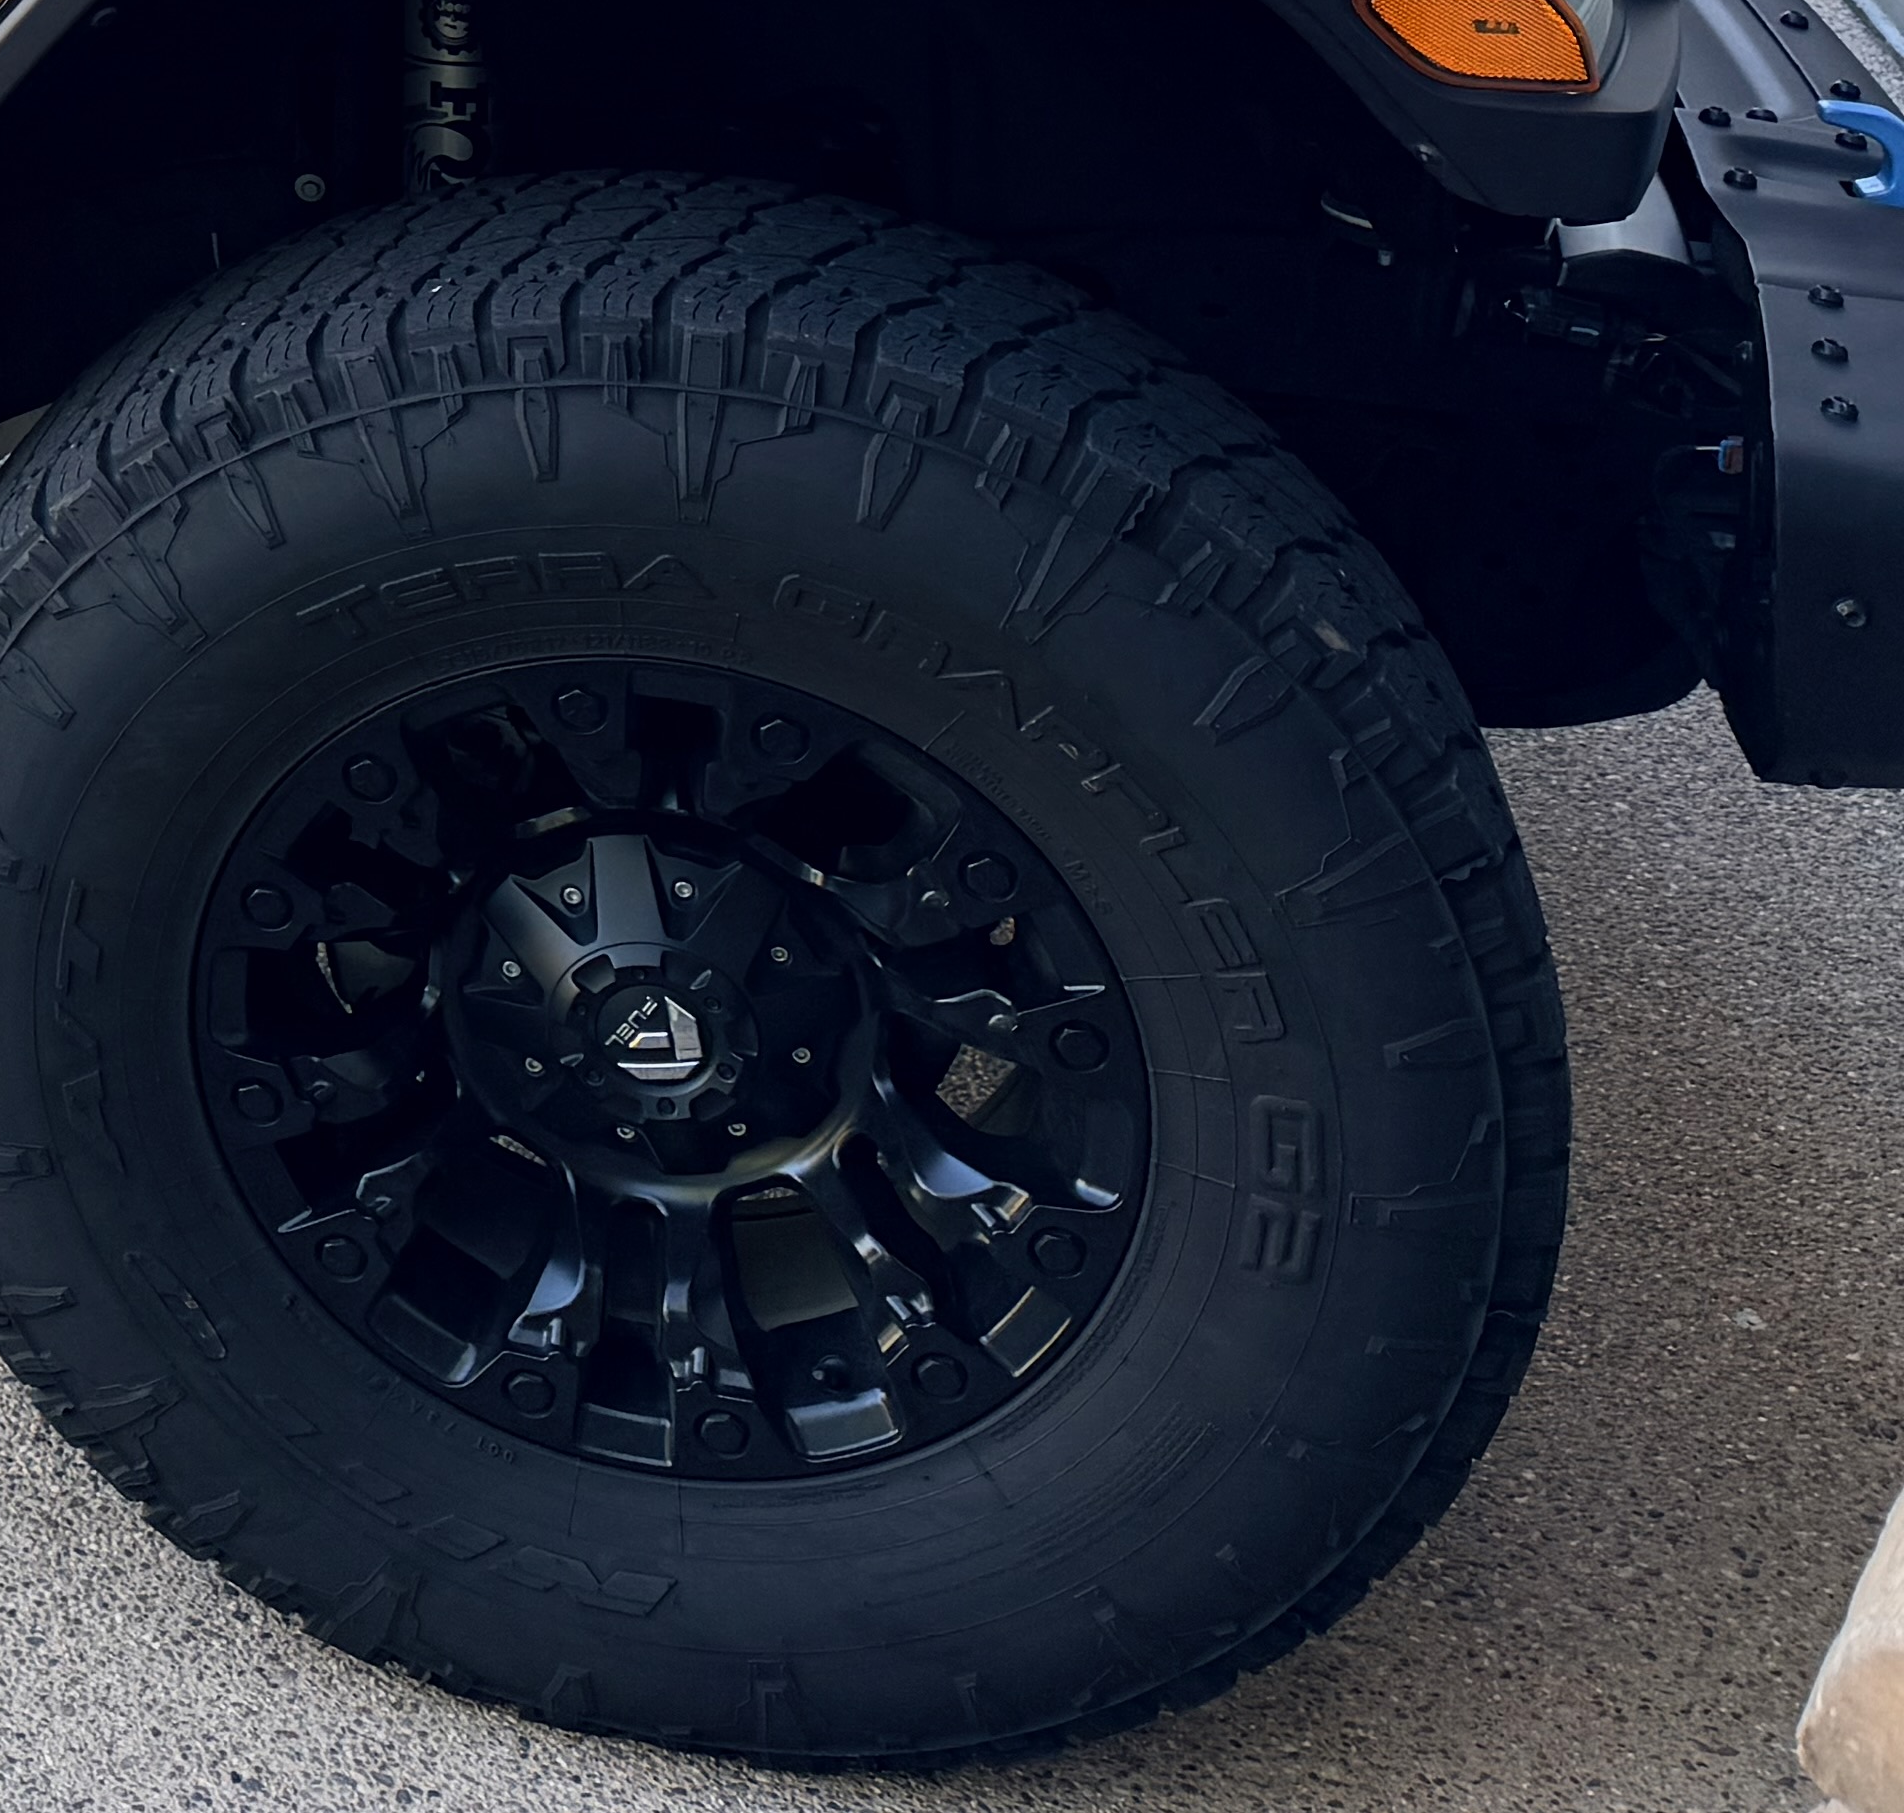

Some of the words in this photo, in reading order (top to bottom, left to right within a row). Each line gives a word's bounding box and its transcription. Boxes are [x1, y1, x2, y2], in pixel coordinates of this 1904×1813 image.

[295, 551, 717, 639] TERRA
[772, 573, 1287, 1041] GRAPPLER
[1239, 1093, 1326, 1286] G2
[604, 995, 658, 1046] FUEL
